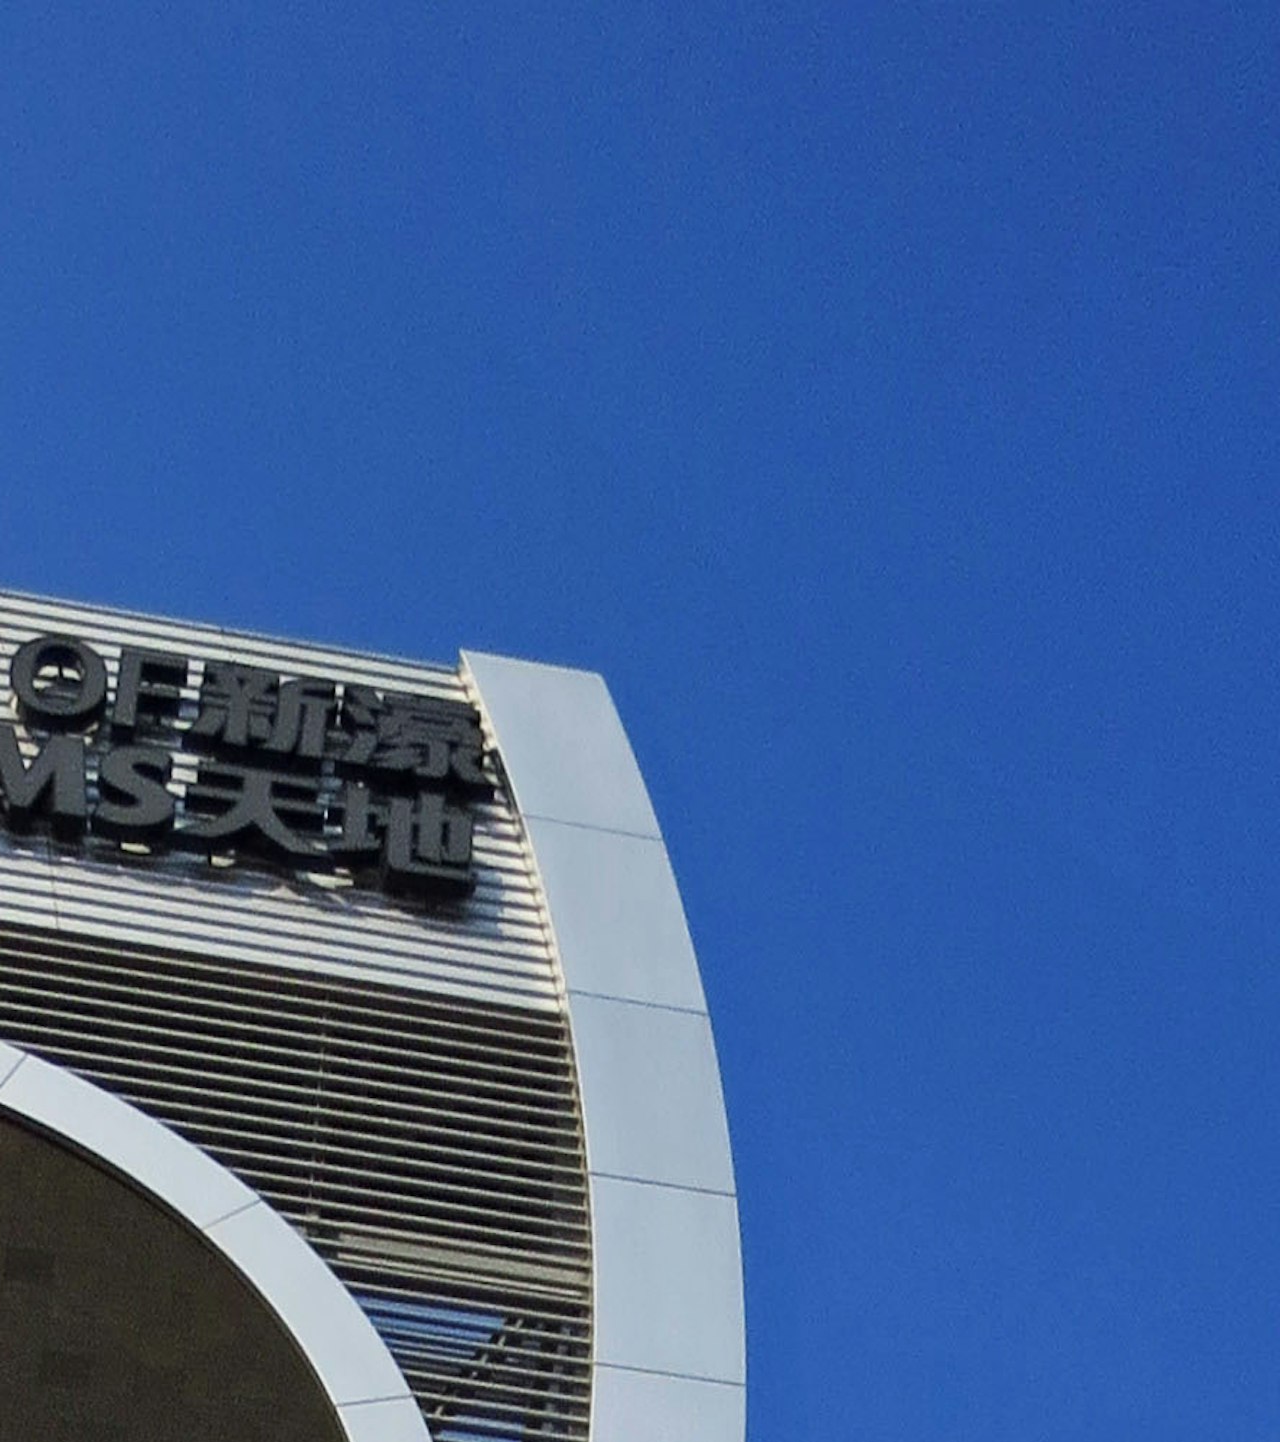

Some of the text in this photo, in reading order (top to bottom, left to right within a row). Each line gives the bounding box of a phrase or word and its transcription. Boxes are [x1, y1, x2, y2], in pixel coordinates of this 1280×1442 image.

[8, 633, 188, 732] OF
[191, 660, 492, 788] 新濠
[168, 757, 476, 884] 天地
